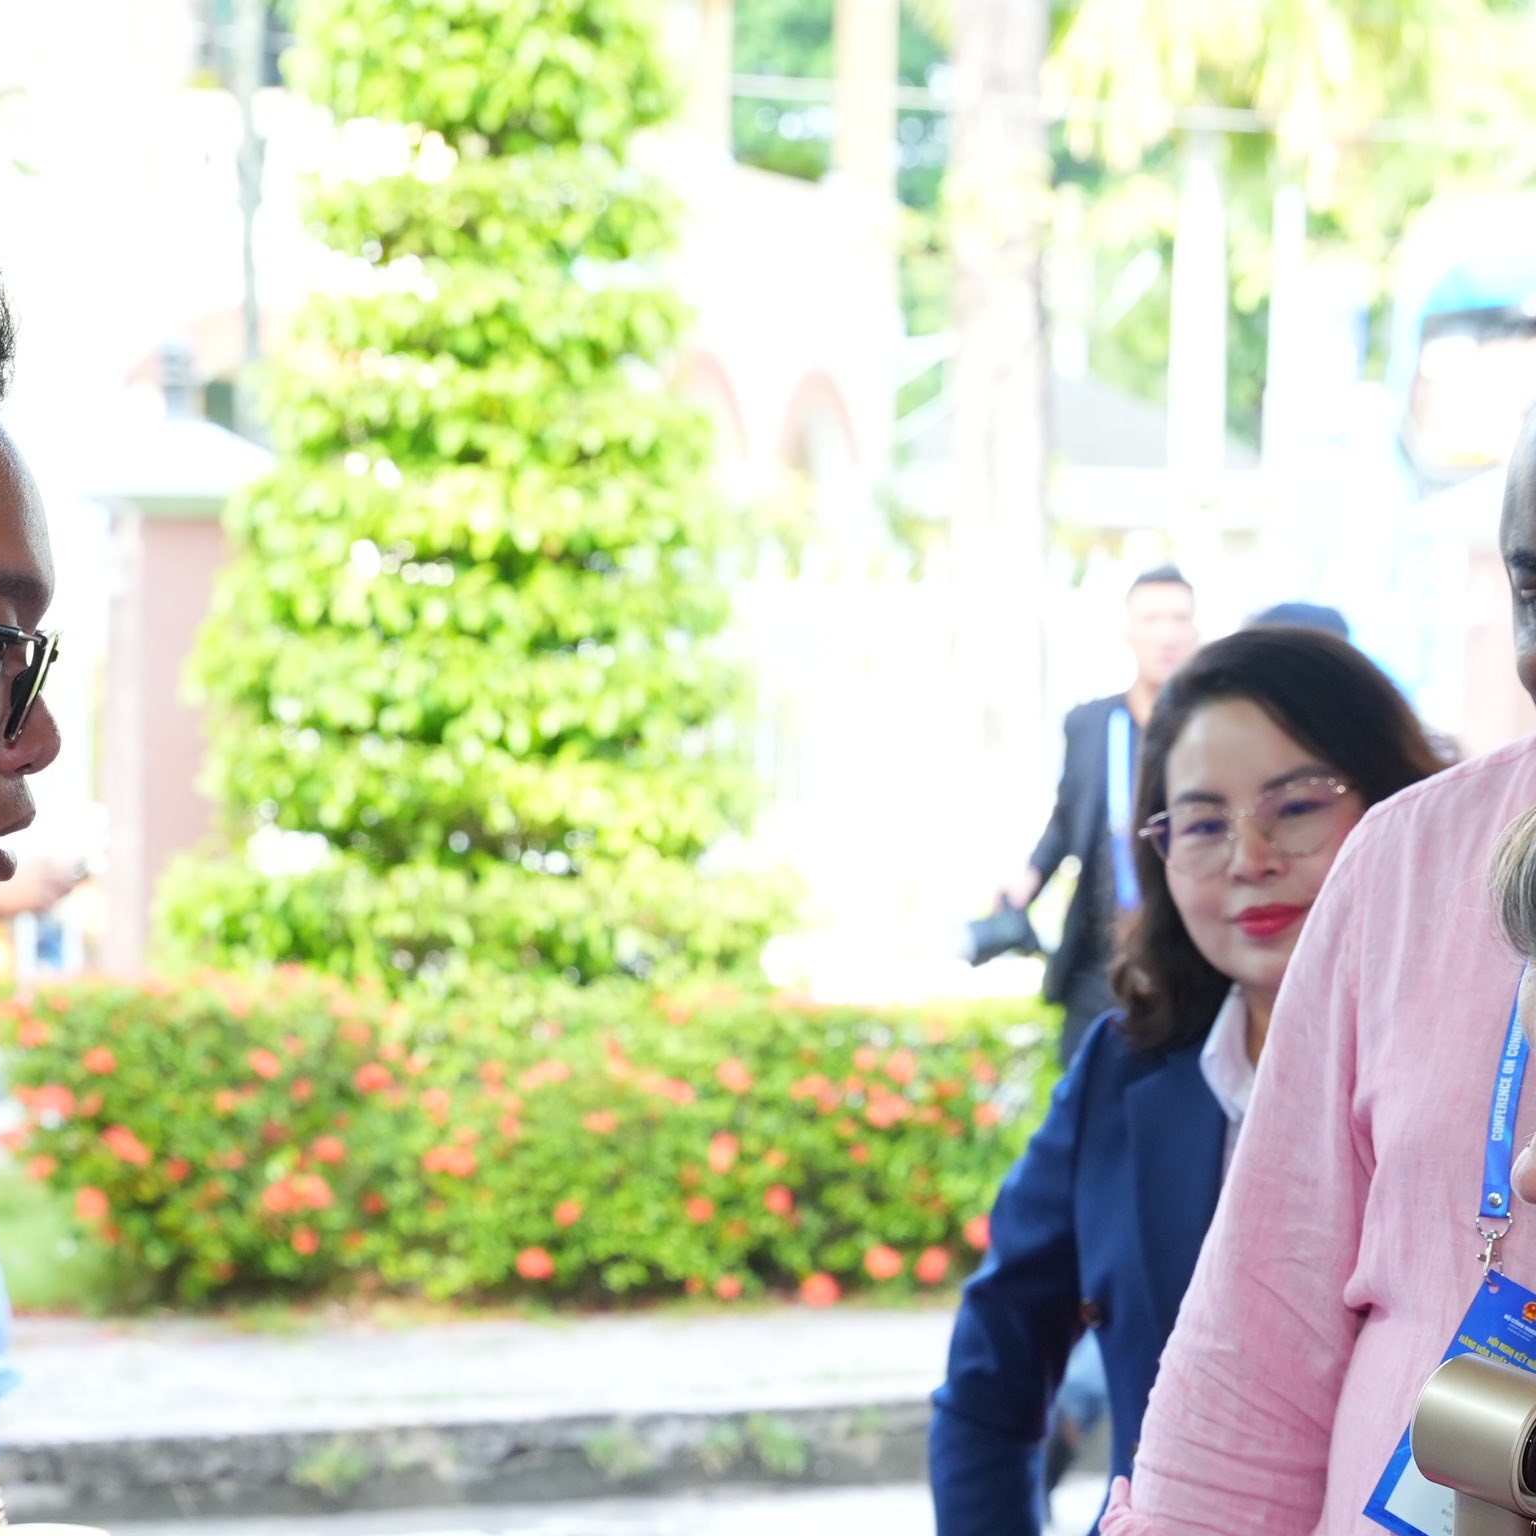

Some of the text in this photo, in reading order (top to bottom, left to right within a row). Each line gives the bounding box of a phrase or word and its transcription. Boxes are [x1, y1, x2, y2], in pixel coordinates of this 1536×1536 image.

[1491, 1016, 1524, 1142] CONFERENCE ON CONNEC
